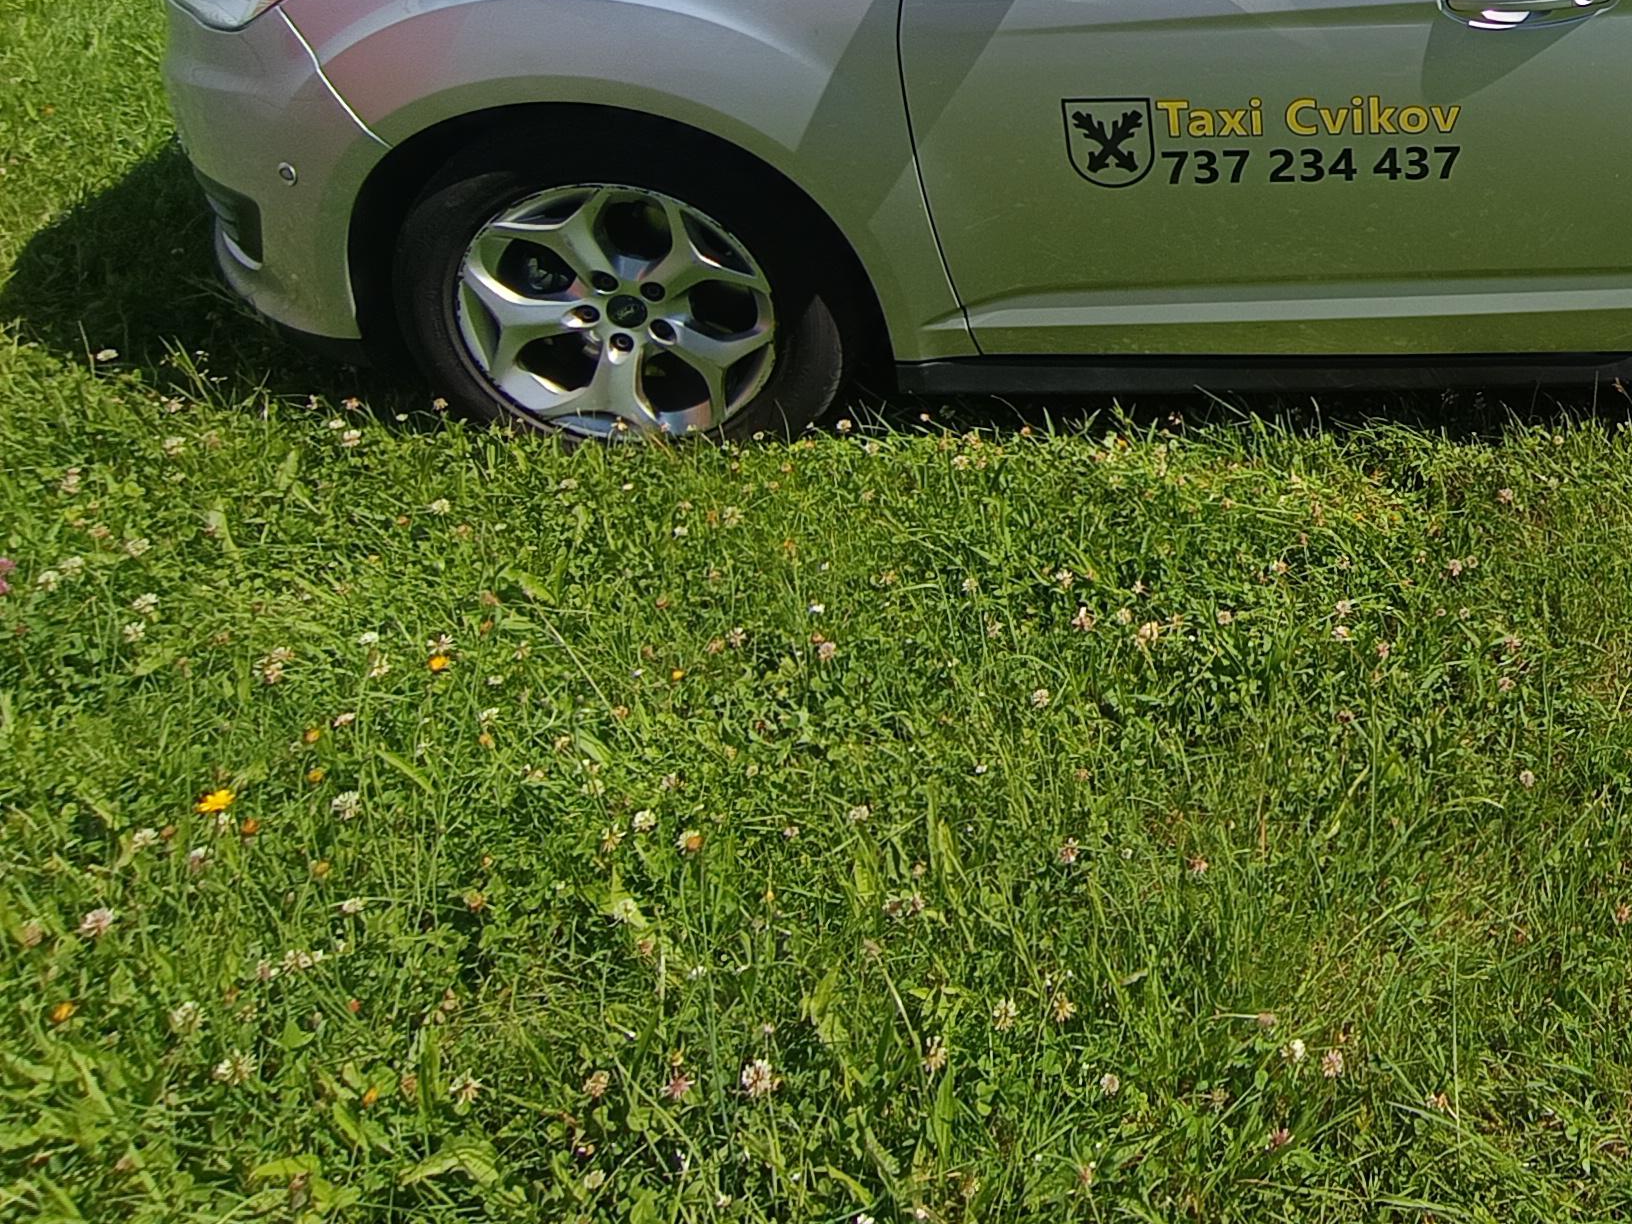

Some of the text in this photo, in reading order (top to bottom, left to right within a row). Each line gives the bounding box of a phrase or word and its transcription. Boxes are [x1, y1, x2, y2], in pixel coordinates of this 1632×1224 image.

[1155, 96, 1461, 138] Taxi Cvikov
[1161, 146, 1461, 185] 737 234 437
